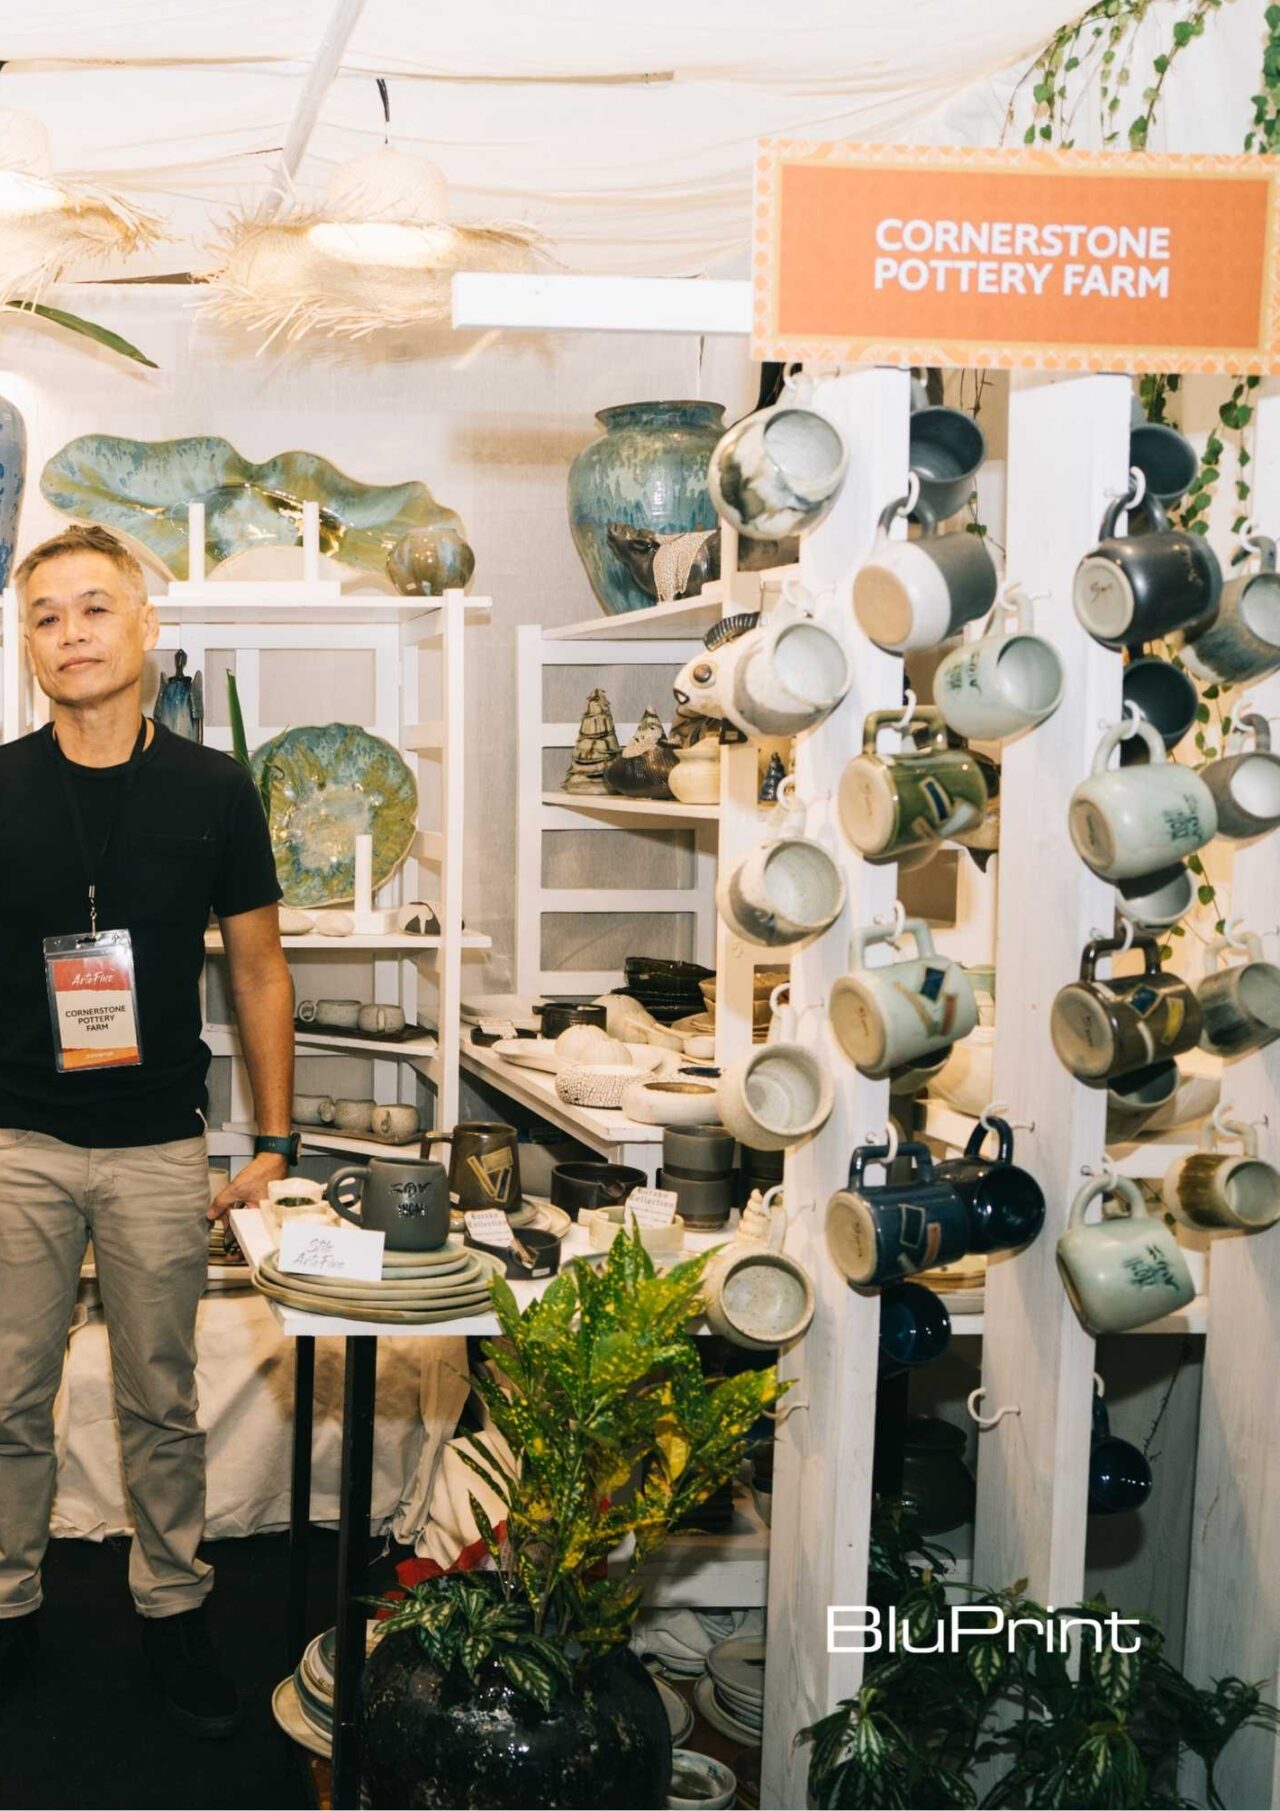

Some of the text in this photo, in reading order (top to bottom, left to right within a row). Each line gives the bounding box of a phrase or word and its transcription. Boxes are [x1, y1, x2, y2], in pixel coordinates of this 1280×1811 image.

[874, 218, 1171, 259] CORNERSTONE
[873, 258, 1170, 299] POTTERY FARM
[65, 1005, 126, 1018] CORNERSTONE
[78, 1014, 115, 1025] POTTERY
[86, 1023, 109, 1032] FARM
